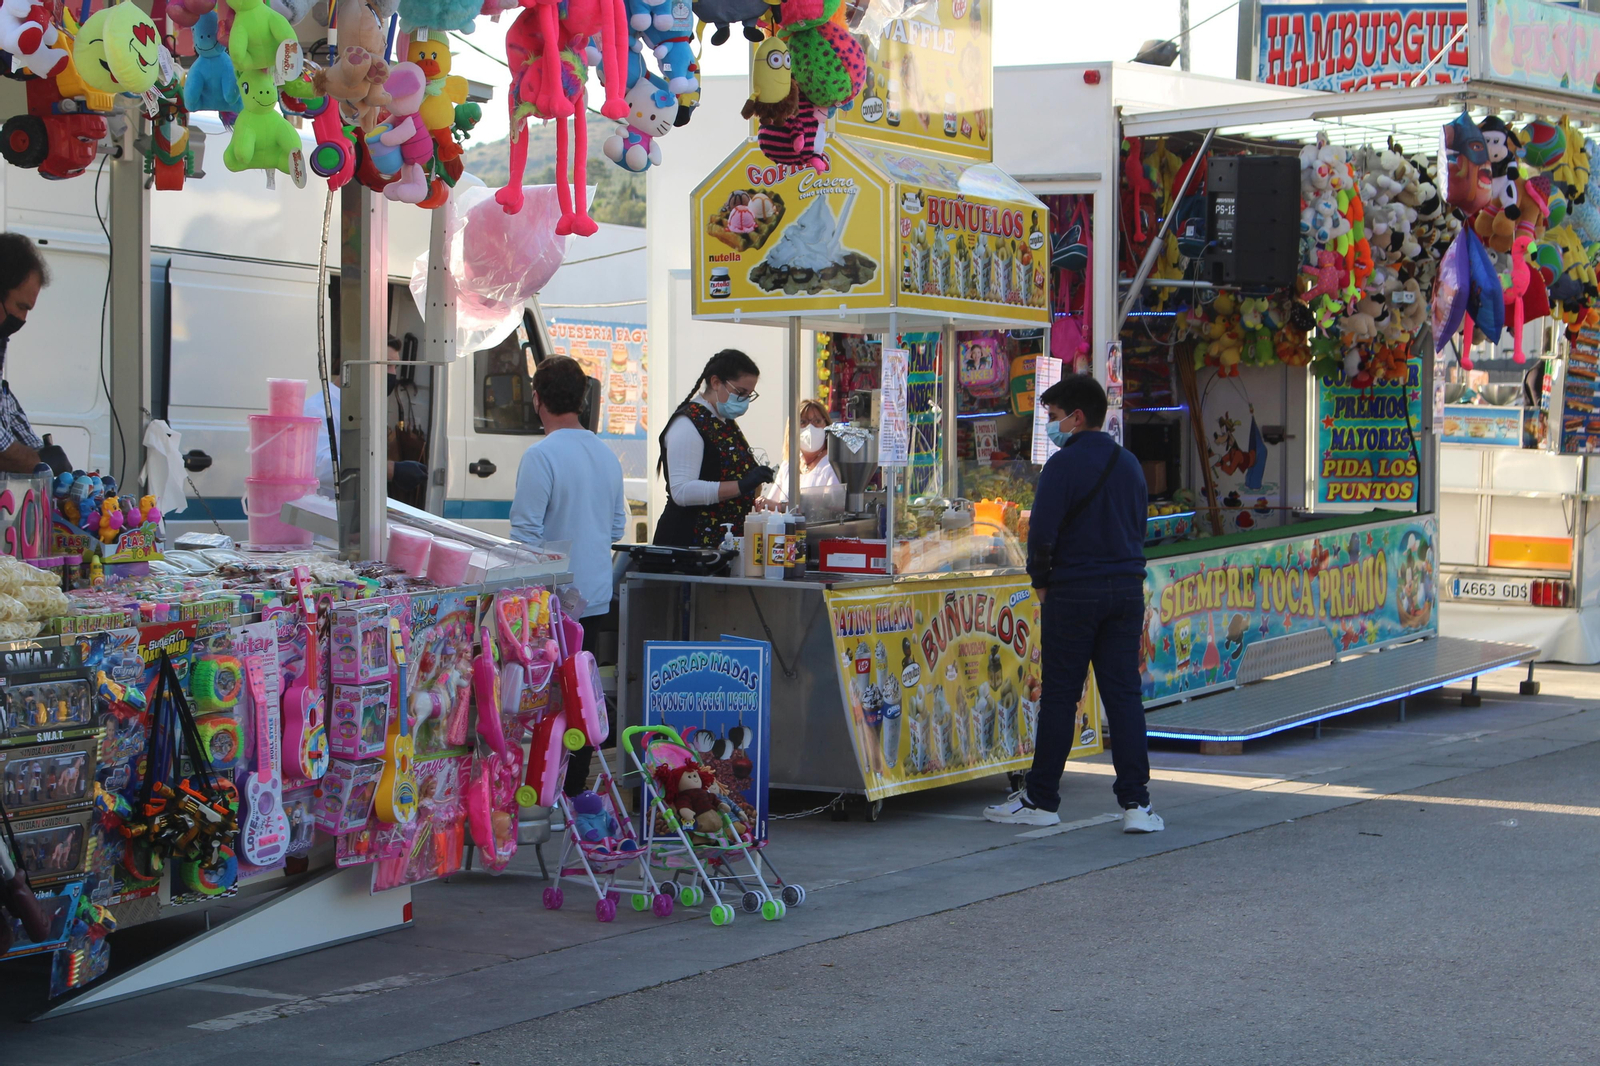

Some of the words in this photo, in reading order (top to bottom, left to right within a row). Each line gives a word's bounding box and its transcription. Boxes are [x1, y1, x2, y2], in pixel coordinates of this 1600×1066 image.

[862, 103, 883, 118] conguitos
[798, 173, 855, 192] Casero
[799, 191, 815, 200] COMO
[927, 192, 1024, 240] BUÑUELOS
[708, 252, 741, 262] nutella
[1333, 395, 1407, 419] PREMIOS
[1330, 427, 1412, 451] MAYORES
[1322, 459, 1374, 478] PIDA
[1377, 459, 1419, 478] LOS
[1326, 482, 1414, 501] PUNTOS
[56, 535, 91, 549] FLASH
[120, 532, 153, 550] FLASH
[132, 547, 151, 560] TOY
[1160, 565, 1256, 625] SIEMPRE
[1258, 566, 1316, 618] TOCA
[1318, 548, 1388, 619] PREMIO
[1463, 581, 1496, 597] 4663
[1009, 590, 1030, 606] OREO
[875, 600, 915, 634] HELADO
[921, 590, 1030, 673] BUÑUELOS
[902, 665, 920, 684] conguitos
[650, 691, 694, 712] PRODUCTO
[37, 730, 64, 742] S.W.A.T.
[23, 746, 47, 757] INDIAN
[18, 819, 40, 831] INDIAN
[247, 819, 258, 853] LOVE
[34, 889, 53, 899] ribal
